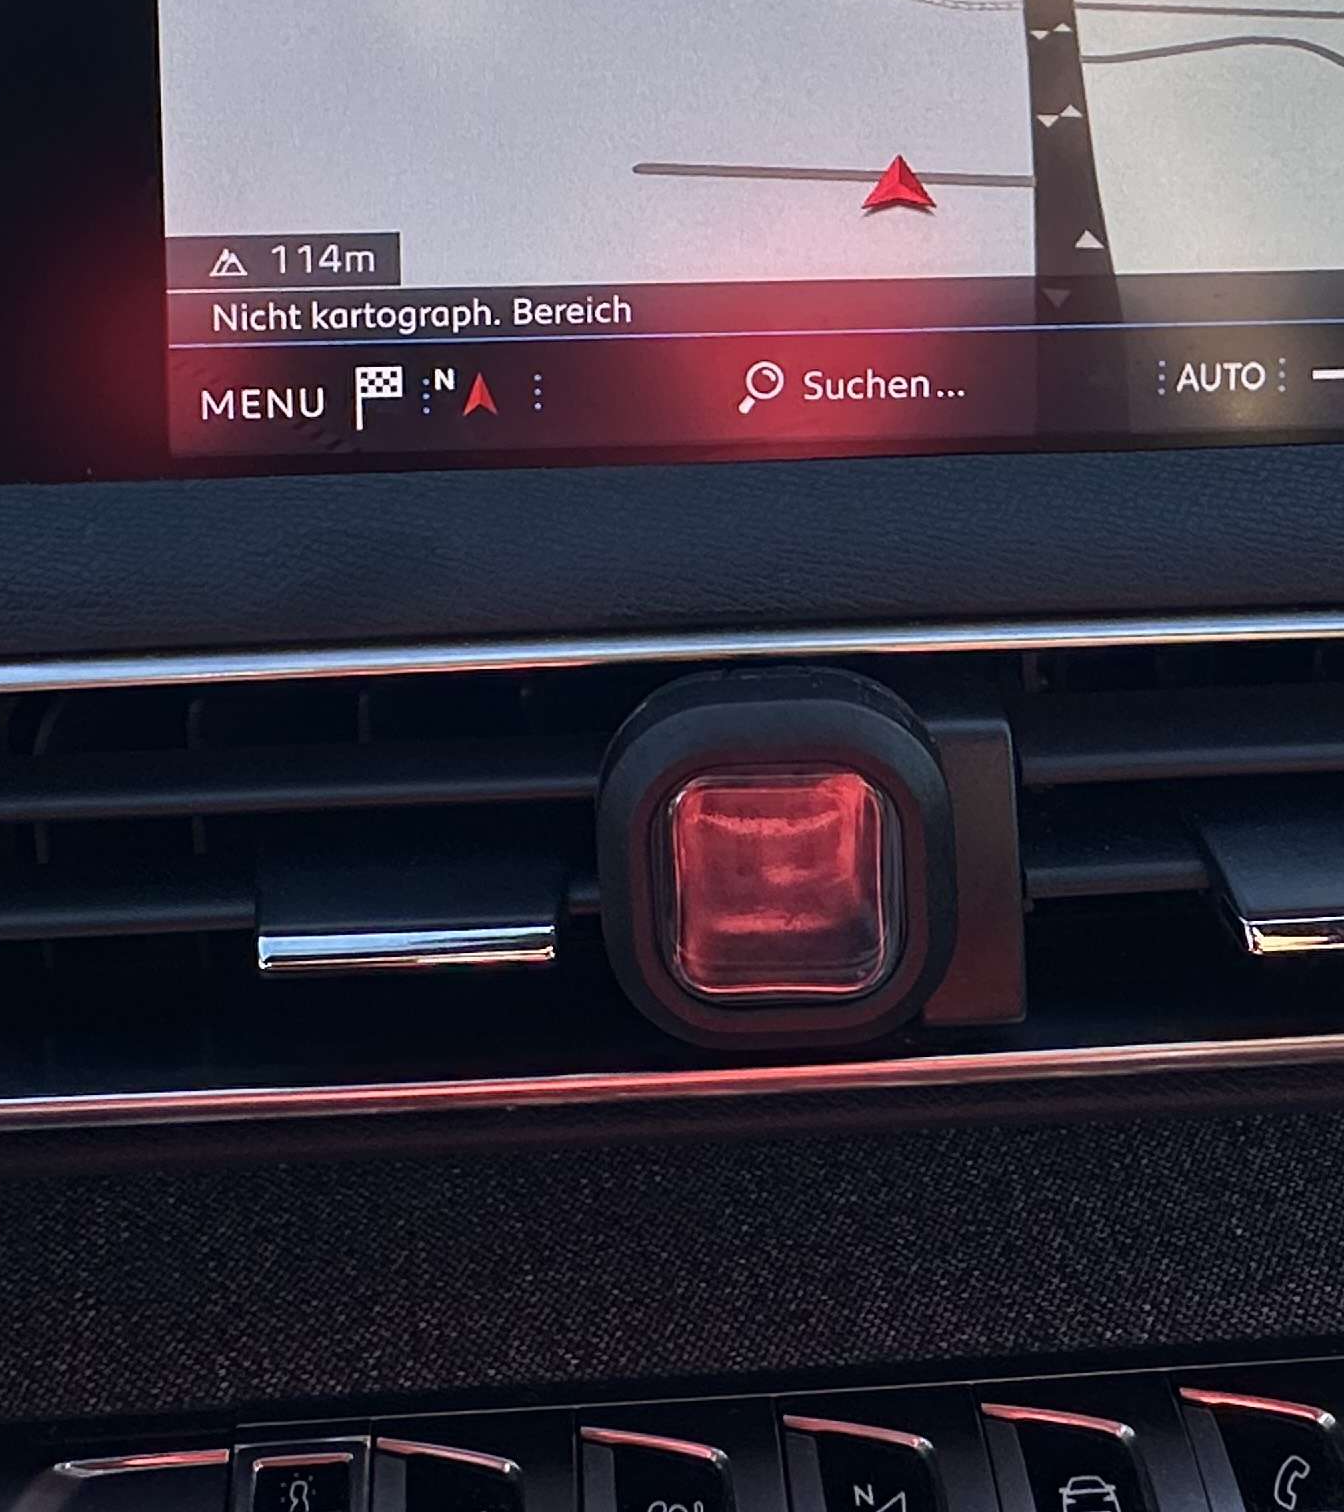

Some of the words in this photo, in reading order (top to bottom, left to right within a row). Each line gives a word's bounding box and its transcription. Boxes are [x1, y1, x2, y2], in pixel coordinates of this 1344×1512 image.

[271, 243, 376, 275] 114m
[212, 303, 302, 332] Nicht
[311, 299, 501, 336] kartograph.
[513, 296, 633, 326] Bereich
[434, 368, 456, 392] N
[1175, 360, 1267, 393] AUTO
[201, 388, 326, 422] MENU
